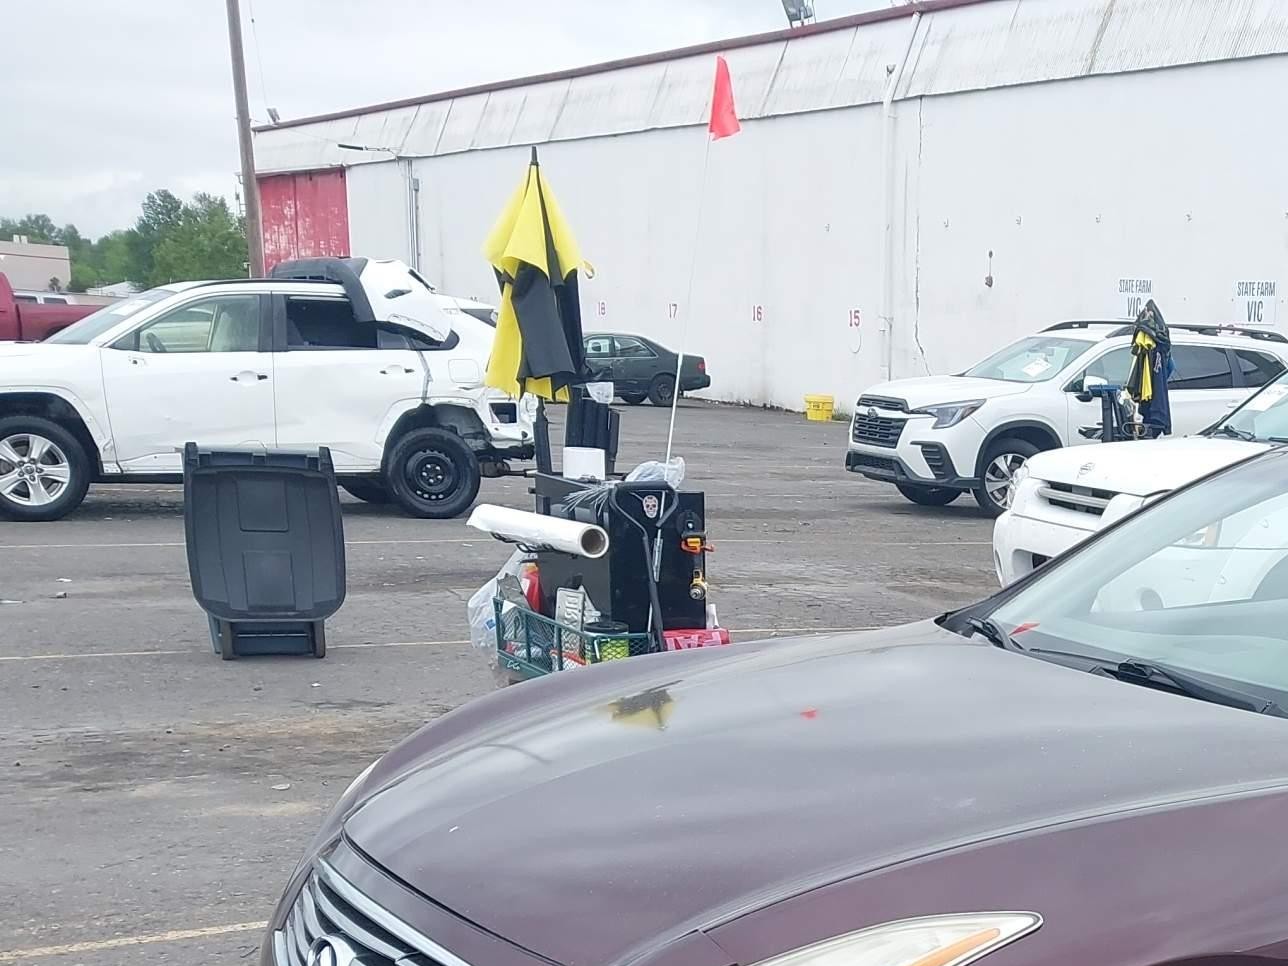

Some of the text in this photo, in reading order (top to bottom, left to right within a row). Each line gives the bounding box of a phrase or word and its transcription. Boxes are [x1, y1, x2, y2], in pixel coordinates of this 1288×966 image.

[1118, 279, 1152, 294] STATE FARM
[1237, 281, 1276, 297] STATE FARM
[598, 301, 606, 316] 18
[668, 303, 678, 320] 17
[752, 304, 763, 322] 16
[1127, 297, 1142, 318] VIC
[1247, 300, 1264, 323] VIC
[849, 309, 861, 328] 15
